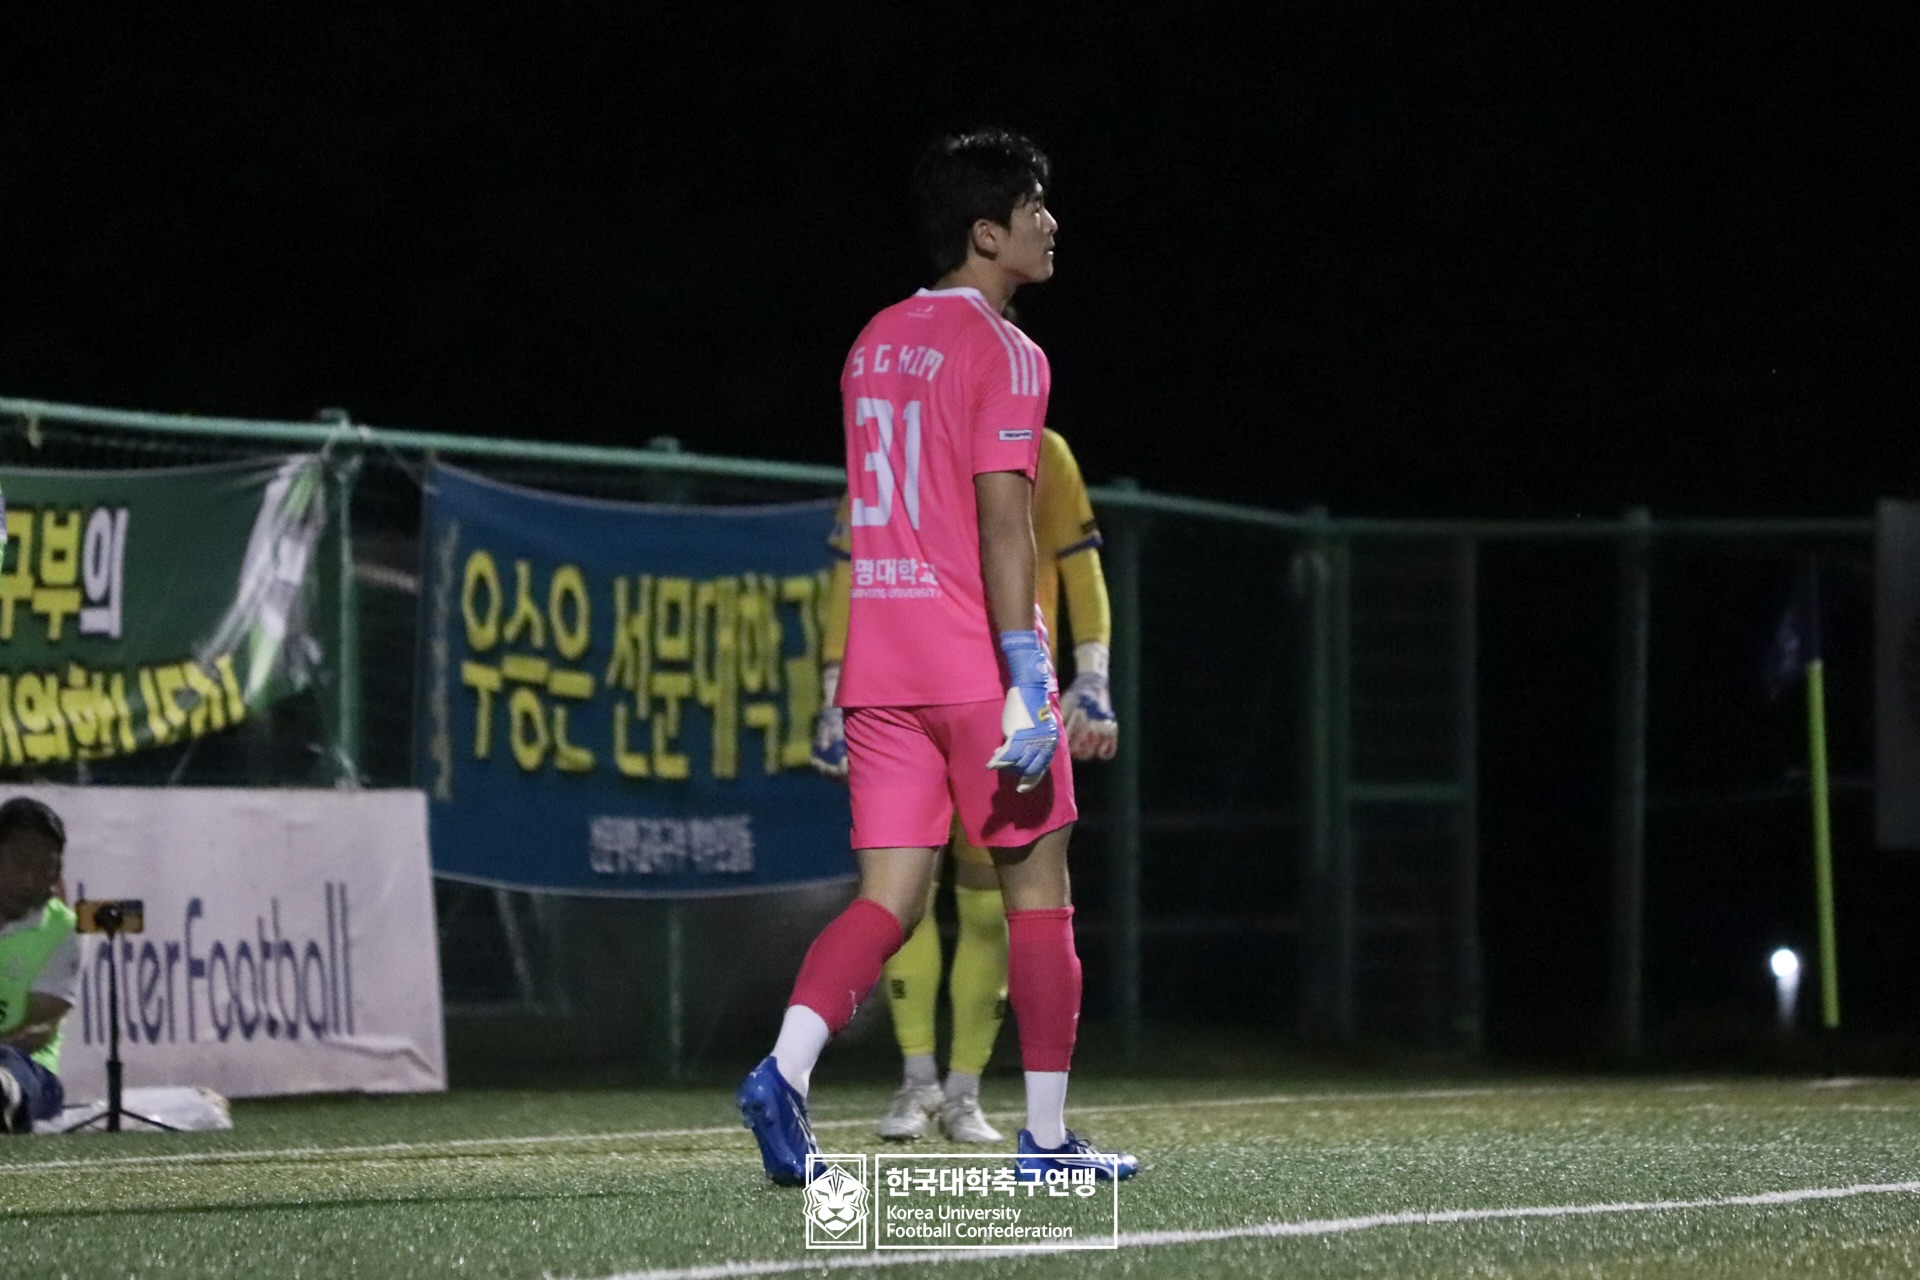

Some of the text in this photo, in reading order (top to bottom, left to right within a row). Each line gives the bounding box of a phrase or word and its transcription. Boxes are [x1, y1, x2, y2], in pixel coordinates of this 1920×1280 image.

[851, 344, 945, 382] S G KIM
[852, 396, 921, 531] 31
[851, 558, 939, 586] 명대학교
[462, 550, 595, 772] 우승은
